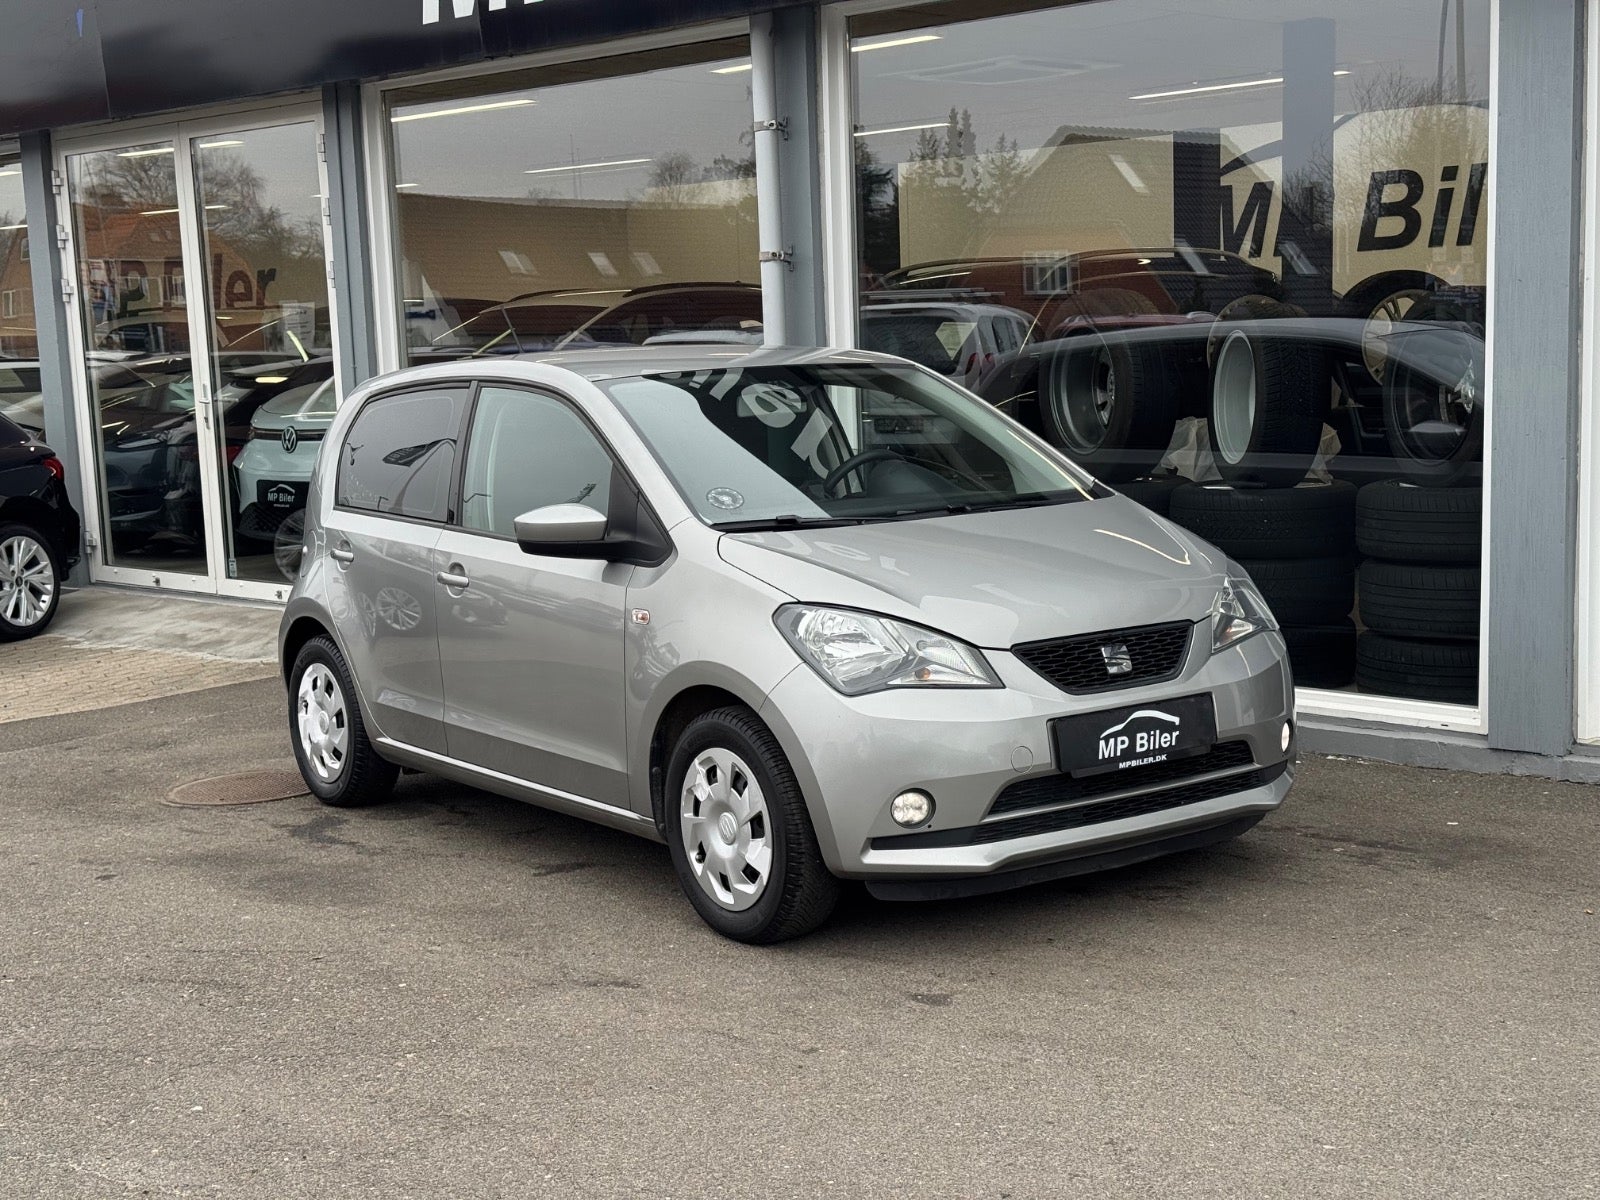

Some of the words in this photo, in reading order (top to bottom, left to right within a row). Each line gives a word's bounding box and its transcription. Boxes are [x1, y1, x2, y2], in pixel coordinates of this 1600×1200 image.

[267, 492, 278, 502] MP
[279, 492, 295, 502] Biler
[1098, 735, 1129, 760] MP
[1135, 729, 1180, 753] Biler
[1118, 753, 1168, 769] MPBILER.DK
